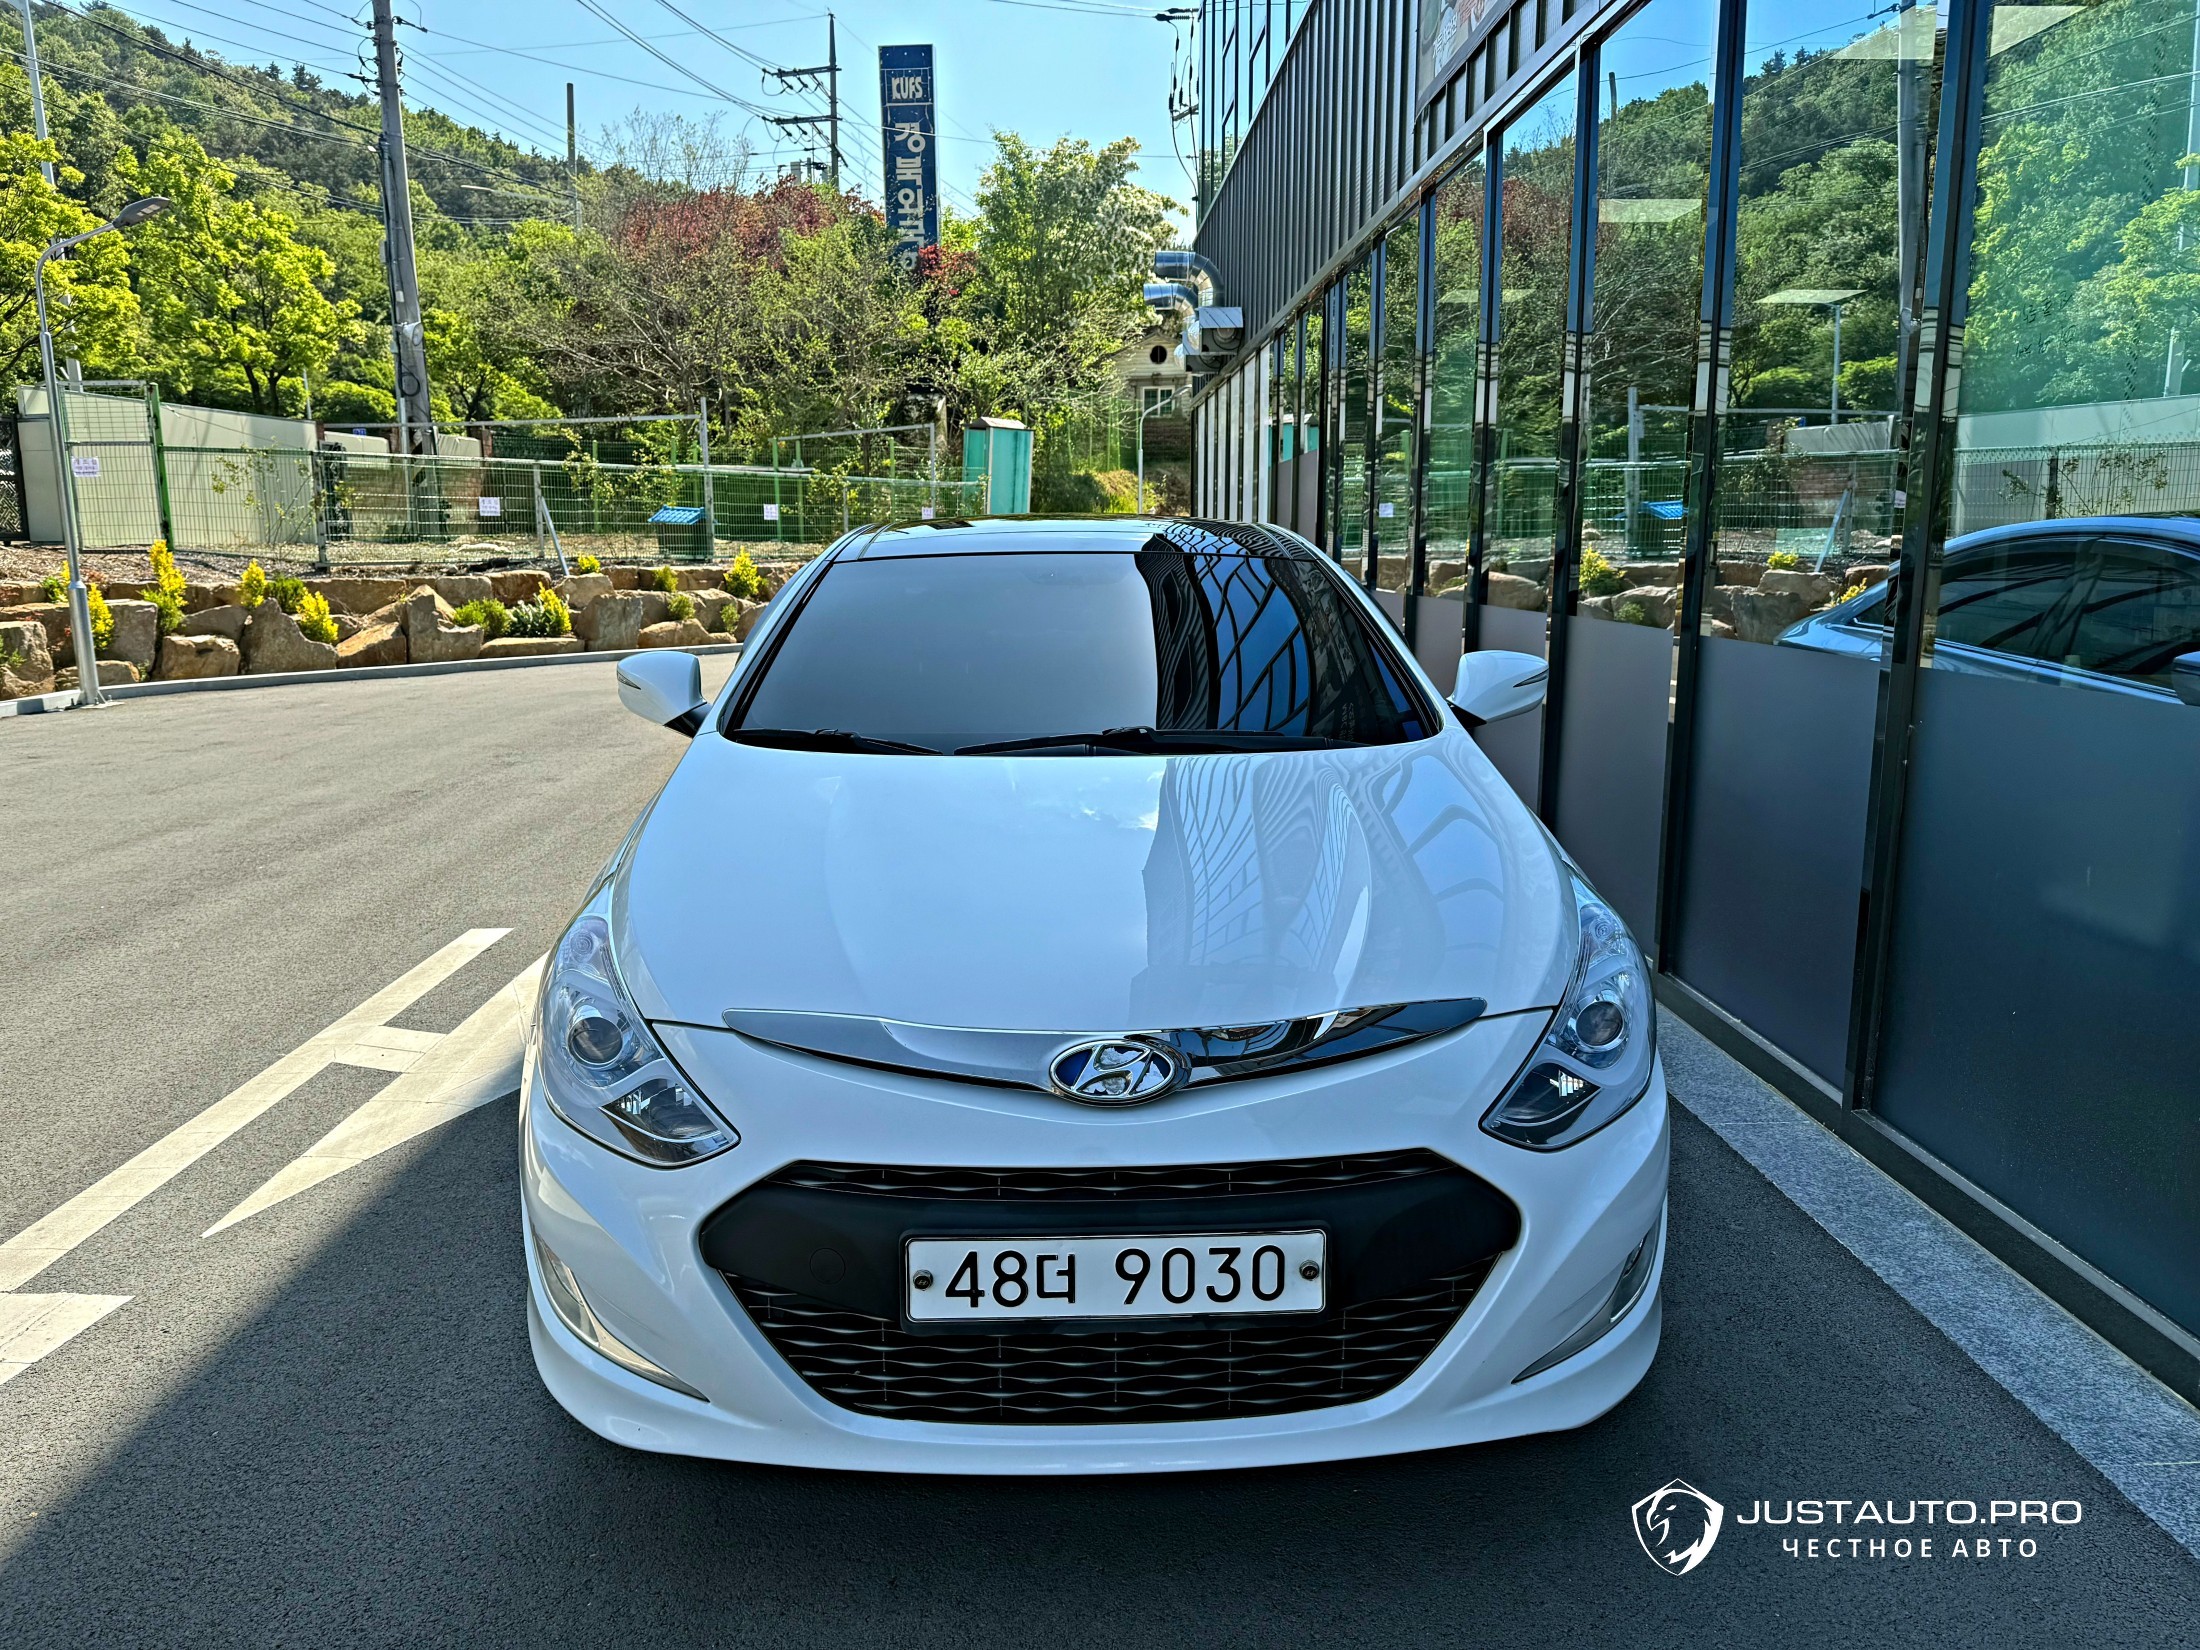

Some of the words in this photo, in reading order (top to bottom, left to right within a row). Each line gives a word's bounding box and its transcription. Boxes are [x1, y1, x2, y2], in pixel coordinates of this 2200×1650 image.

[891, 76, 923, 100] KUFS
[945, 1250, 1076, 1308] 48더
[1115, 1244, 1286, 1305] 9030
